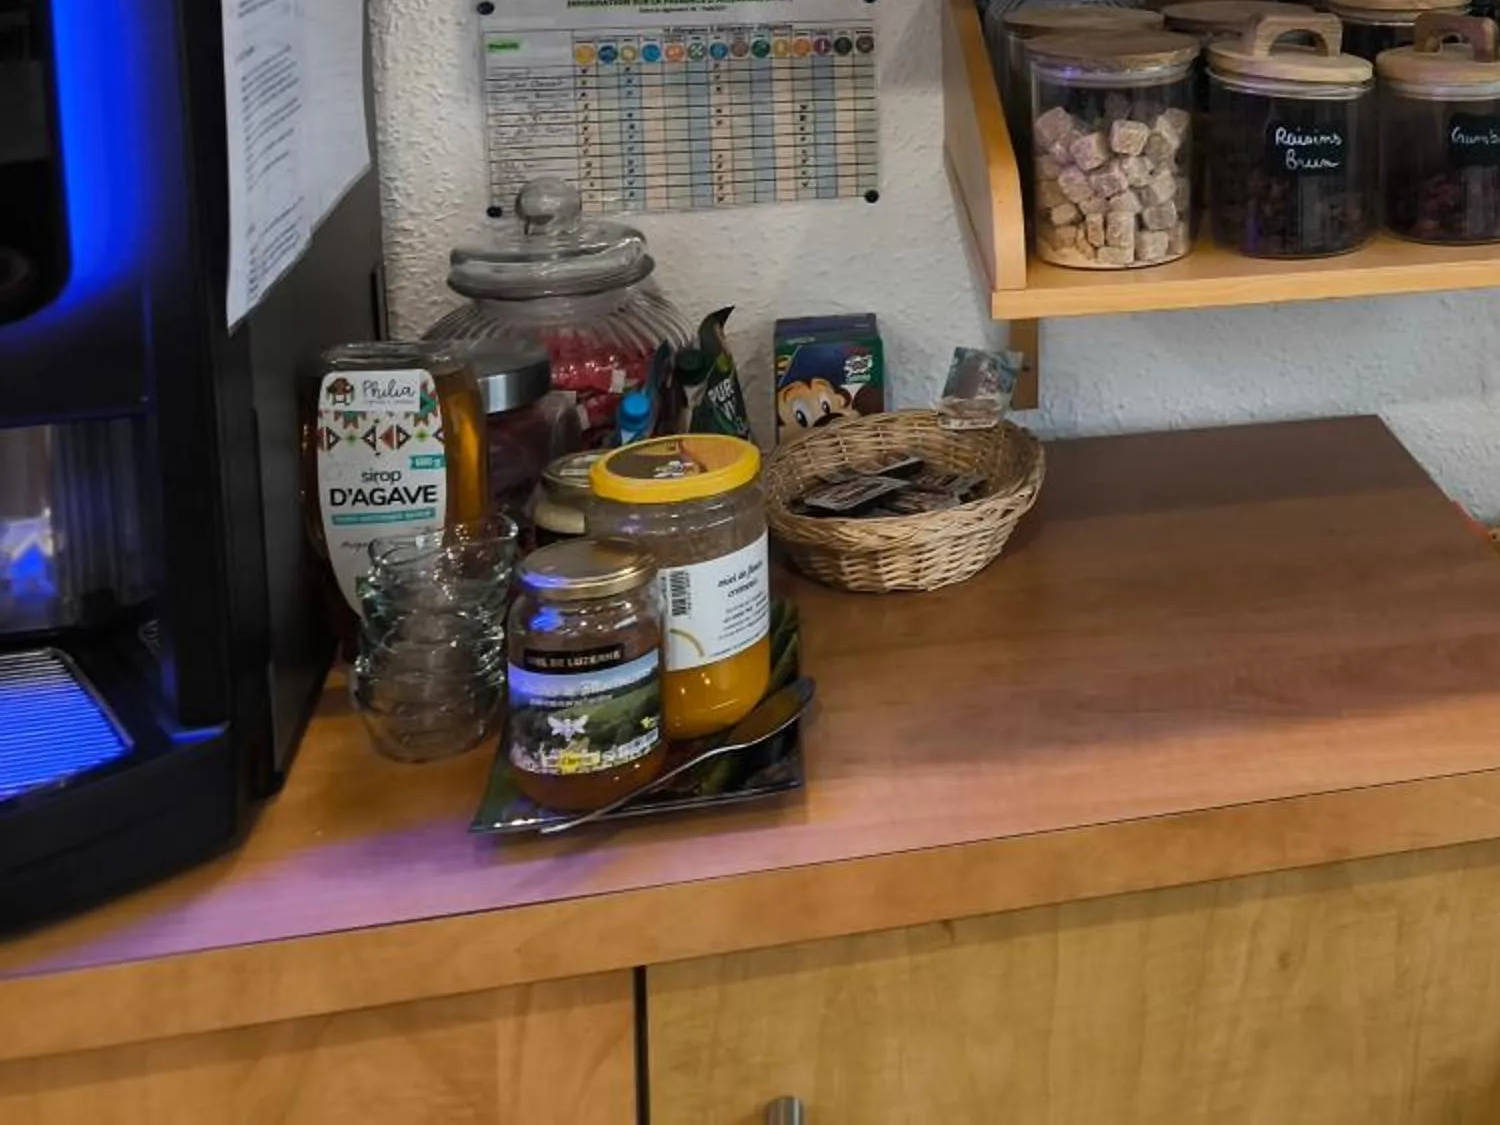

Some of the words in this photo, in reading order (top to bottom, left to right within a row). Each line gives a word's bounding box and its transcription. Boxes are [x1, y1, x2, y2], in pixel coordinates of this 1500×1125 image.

[362, 378, 417, 399] Philia
[361, 467, 403, 484] sirop
[329, 484, 438, 507] D'AGAVE
